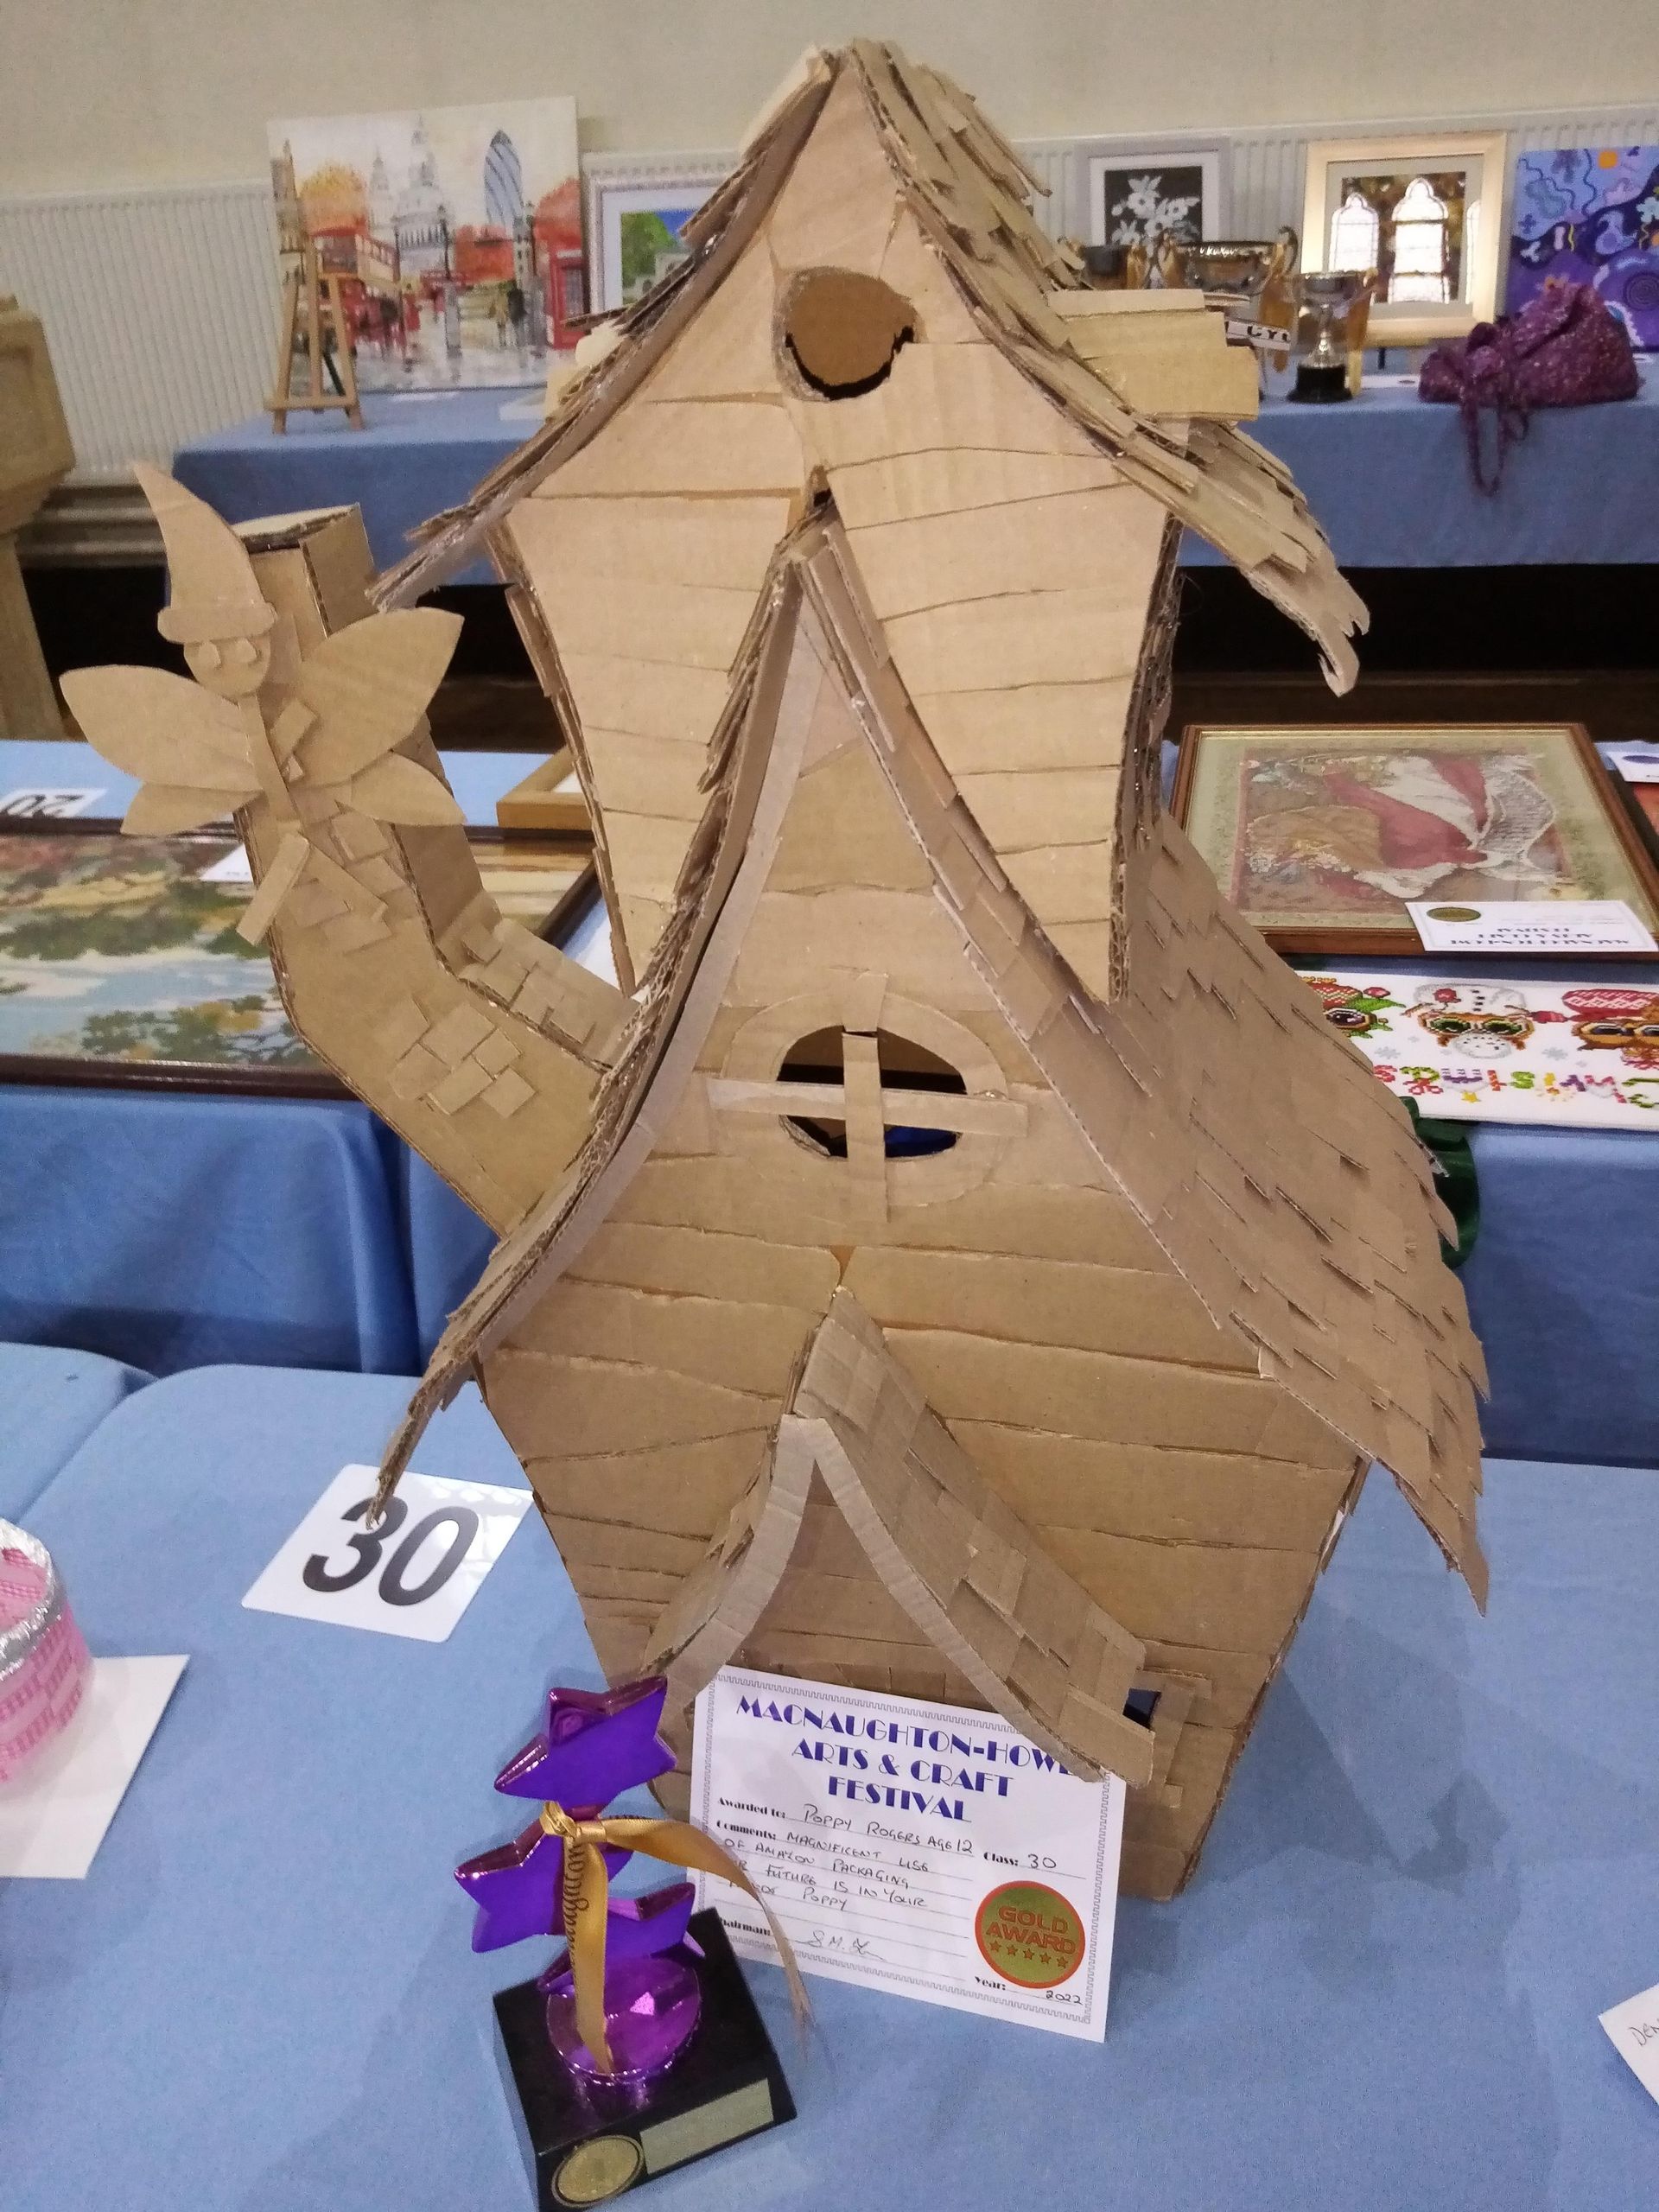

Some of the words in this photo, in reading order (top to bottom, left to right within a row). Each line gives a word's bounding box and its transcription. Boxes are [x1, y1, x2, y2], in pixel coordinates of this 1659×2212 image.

[302, 1496, 479, 1606] 30
[791, 1738, 868, 1770] ARTS
[878, 1754, 899, 1776] &
[910, 1759, 1014, 1796] CRAFT
[828, 1775, 972, 1822] FESTIVAL
[716, 1820, 776, 1840] Comments:
[718, 1796, 767, 1815] Awarded
[771, 1808, 785, 1819] to:
[957, 1839, 973, 1853] 12
[724, 1838, 745, 1848] OF
[833, 1859, 909, 1889] PACKAGING
[983, 1852, 1019, 1866] Class:
[1028, 1853, 1057, 1869] 30
[834, 1880, 849, 1893] IS
[859, 1886, 878, 1897] IN
[998, 1904, 1069, 1934] GOLD
[985, 1921, 1077, 1955] AWARD
[975, 1975, 1006, 1991] Year:
[1046, 1990, 1084, 2005] 2022
